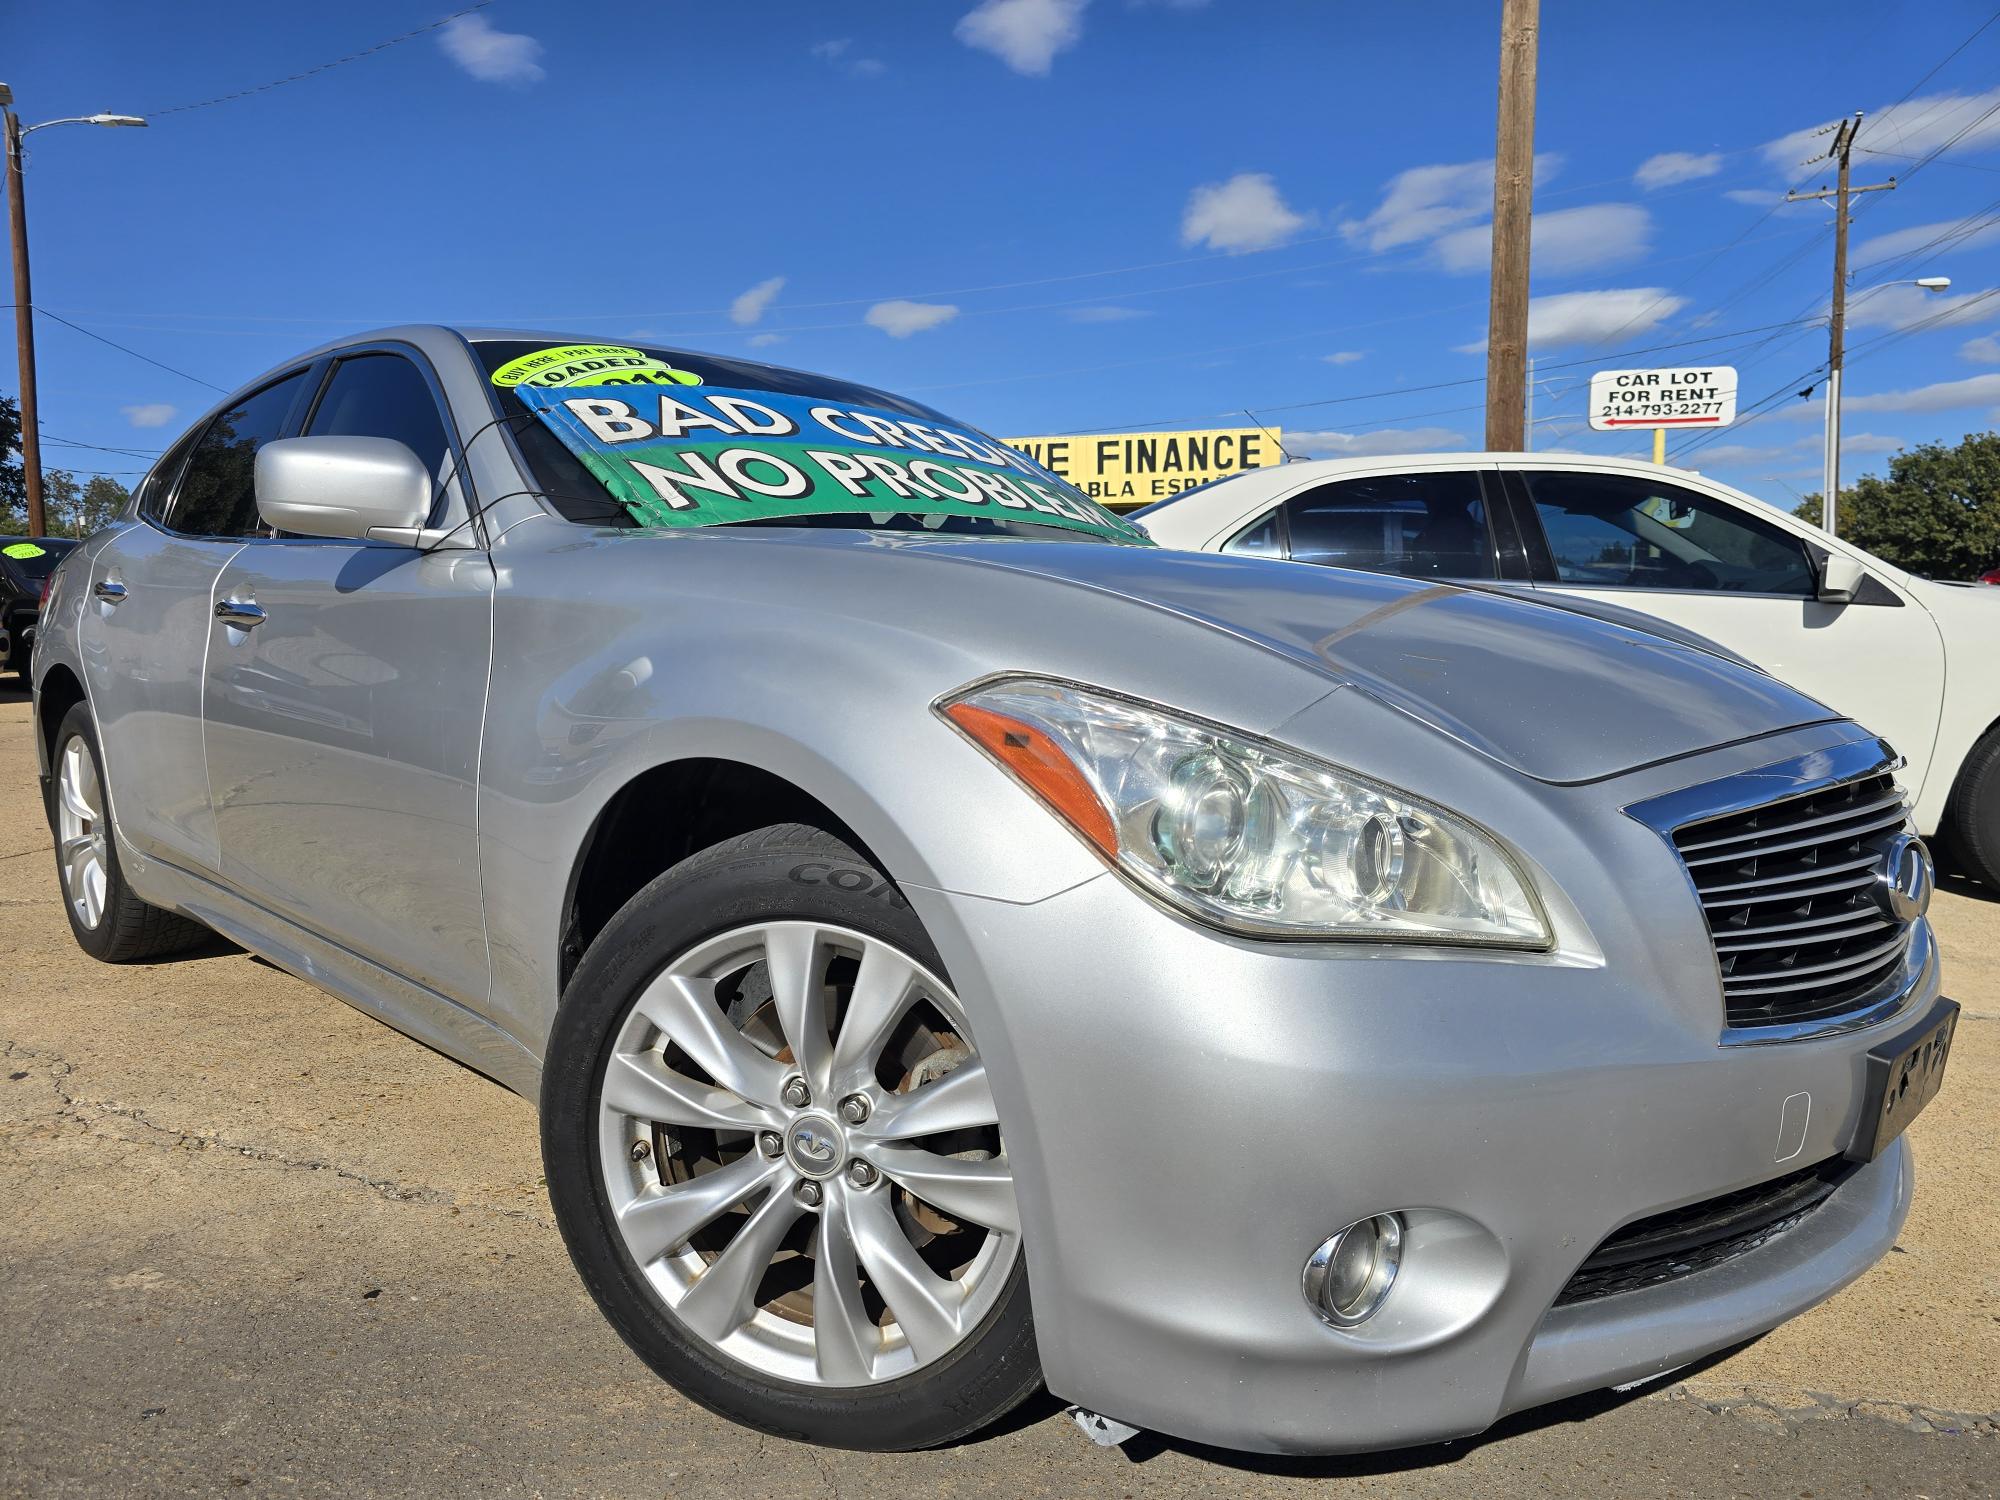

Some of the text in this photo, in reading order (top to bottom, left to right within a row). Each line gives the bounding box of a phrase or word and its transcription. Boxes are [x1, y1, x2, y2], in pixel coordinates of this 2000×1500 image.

[501, 367, 523, 380] BUY
[523, 355, 556, 369] HERE
[563, 349, 595, 357] PAY
[526, 359, 647, 387] LOADED
[600, 371, 682, 385] 11
[1616, 372, 1713, 387] CAR LOT
[1609, 388, 1719, 403] FOR RENT
[563, 394, 800, 444] BAD
[1602, 402, 1723, 417] 214-793-2277
[1097, 435, 1260, 475] FINANCE
[626, 448, 1136, 538] NO PROBLEM
[1151, 474, 1229, 496] ESP
